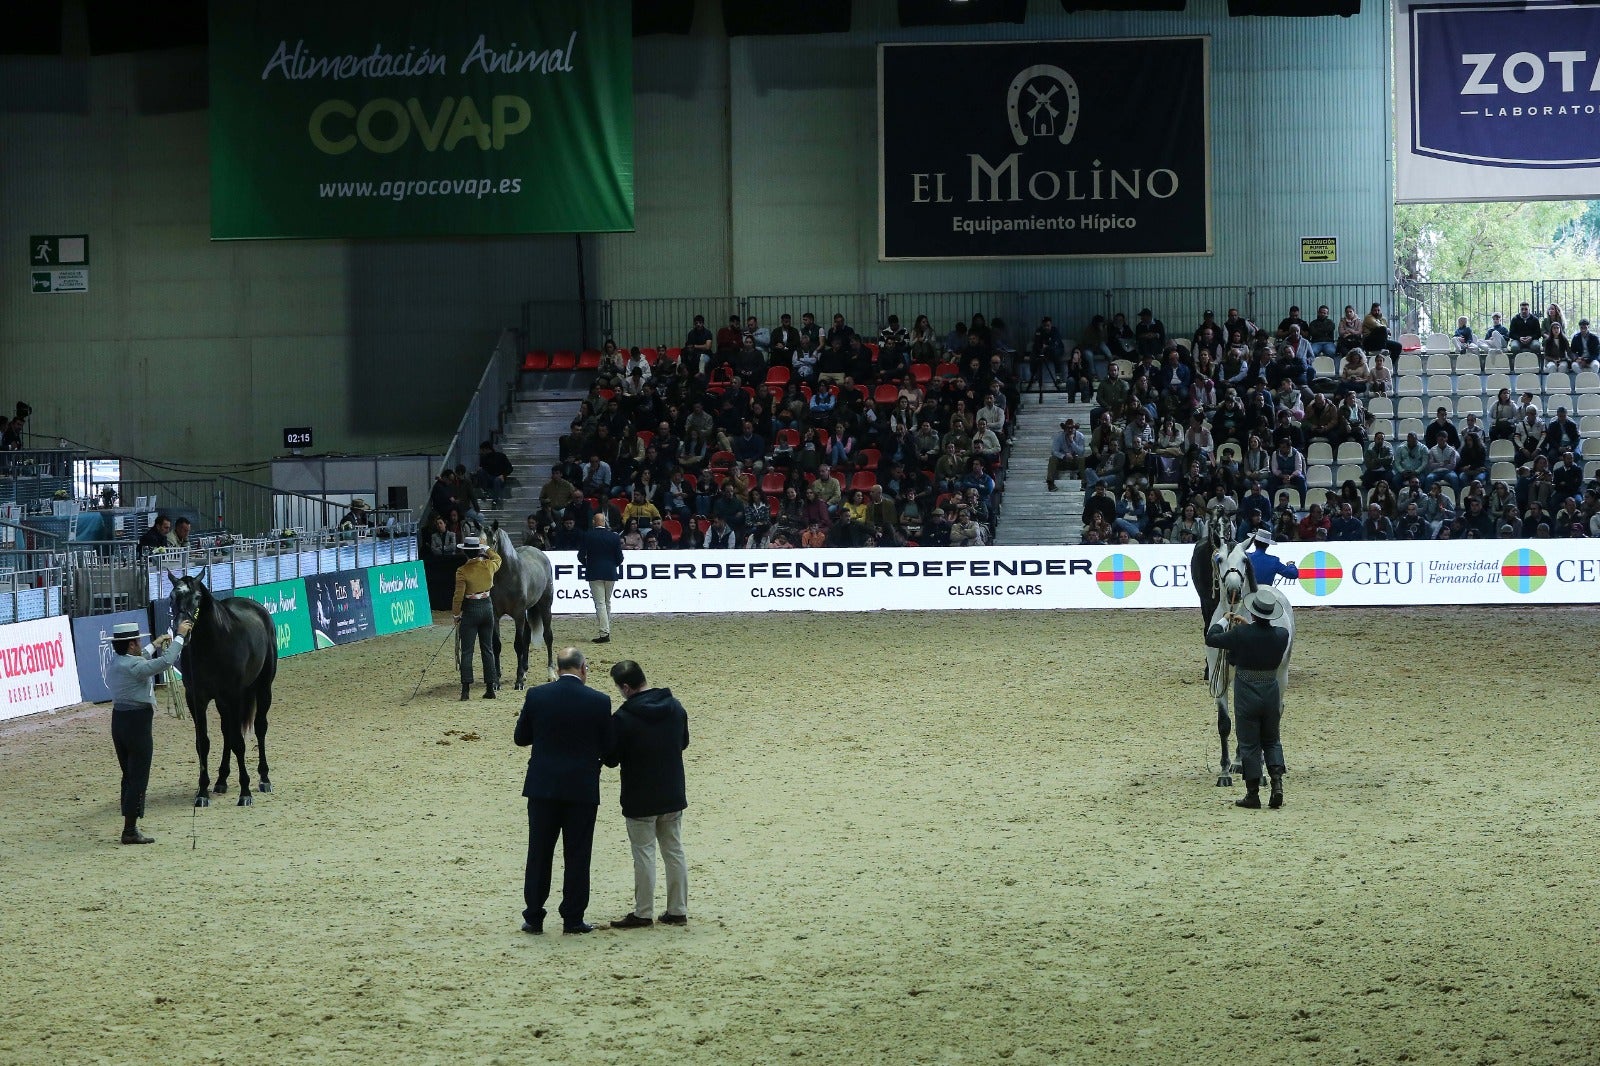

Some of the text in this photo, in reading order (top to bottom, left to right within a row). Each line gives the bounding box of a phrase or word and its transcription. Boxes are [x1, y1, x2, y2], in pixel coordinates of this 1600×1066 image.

[262, 31, 577, 81] Alimentación Animal
[1485, 105, 1600, 117] LABORATO
[308, 95, 532, 155] COVAP
[319, 178, 522, 200] www.agrocovap.es
[911, 173, 953, 203] EL
[953, 213, 1137, 234] Equipamiento Hípico
[287, 433, 310, 443] 02:15
[701, 561, 893, 579] DEFENDER
[898, 559, 1093, 577] DEFENDER
[1351, 562, 1415, 585] CEU
[1428, 560, 1499, 571] Universidad
[1556, 559, 1600, 583] CE
[1149, 564, 1192, 588] CE
[1428, 573, 1484, 584] Fernando
[613, 588, 648, 599] CARS
[750, 586, 844, 598] CLASSIC CARS
[948, 584, 1042, 596] CLASSIC CARS
